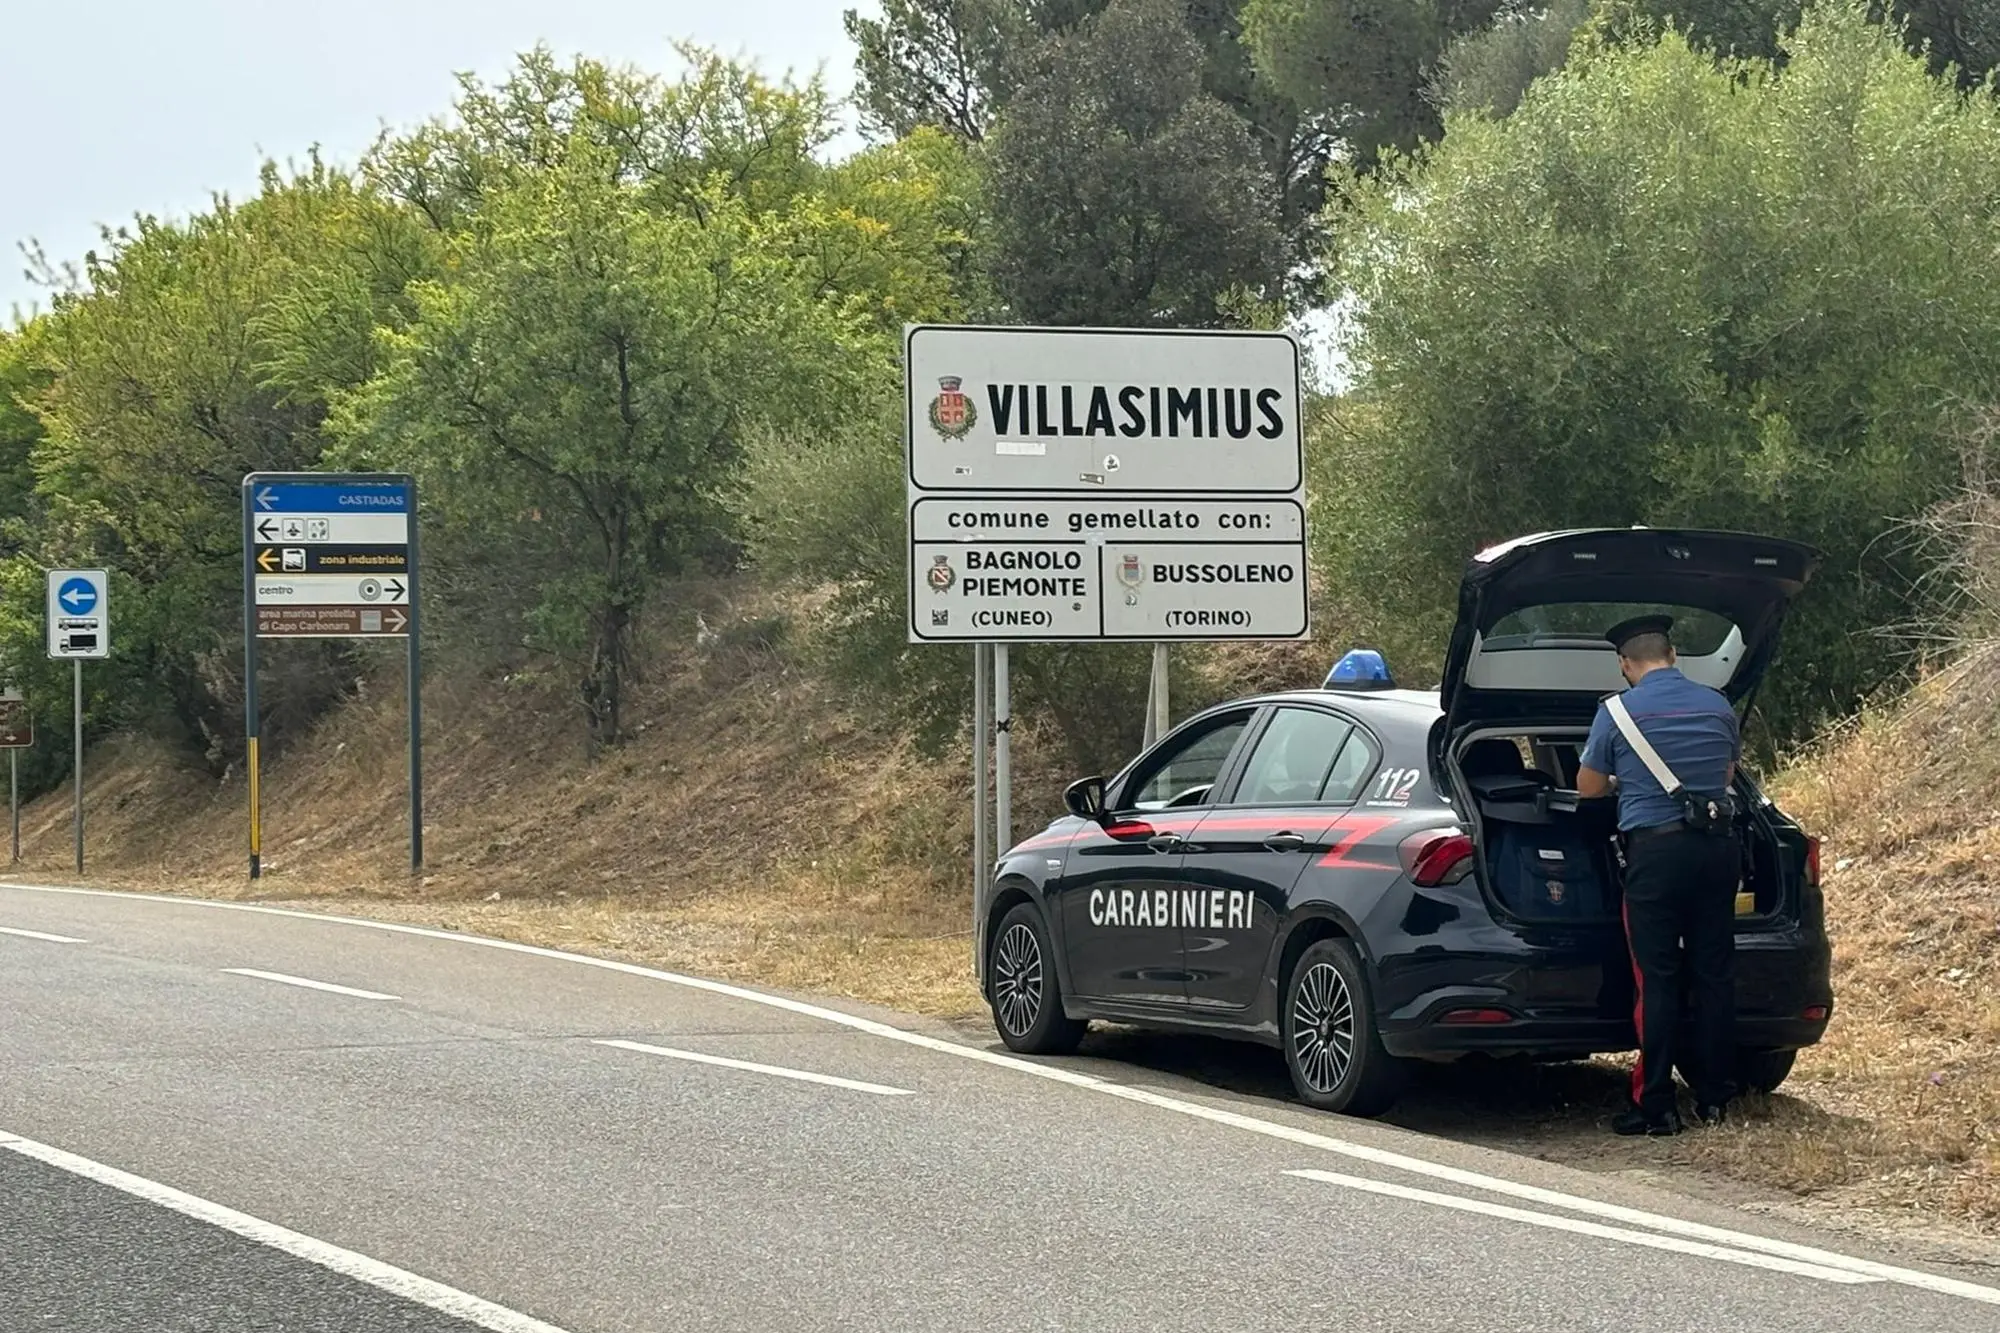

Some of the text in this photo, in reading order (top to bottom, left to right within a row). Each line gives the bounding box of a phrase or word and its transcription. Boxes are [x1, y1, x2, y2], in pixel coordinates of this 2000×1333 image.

[987, 384, 1284, 440] VILLASIMIUS
[338, 495, 404, 506] CASTIADAS
[948, 509, 1272, 532] comune gemellato con:
[319, 554, 405, 565] zona industriale
[966, 551, 1082, 570] BAGNOLO
[1153, 564, 1294, 583] BUSSOLENO
[258, 586, 294, 595] centro
[963, 578, 1086, 597] PIEMONTE
[259, 610, 281, 618] area
[283, 609, 317, 618] marina
[971, 611, 1053, 628] (CUNEO)
[1165, 610, 1252, 628] (TORINO)
[259, 621, 350, 632] di Capo Carbonara
[1373, 767, 1420, 800] 112
[1089, 888, 1255, 930] CARABINIERI
